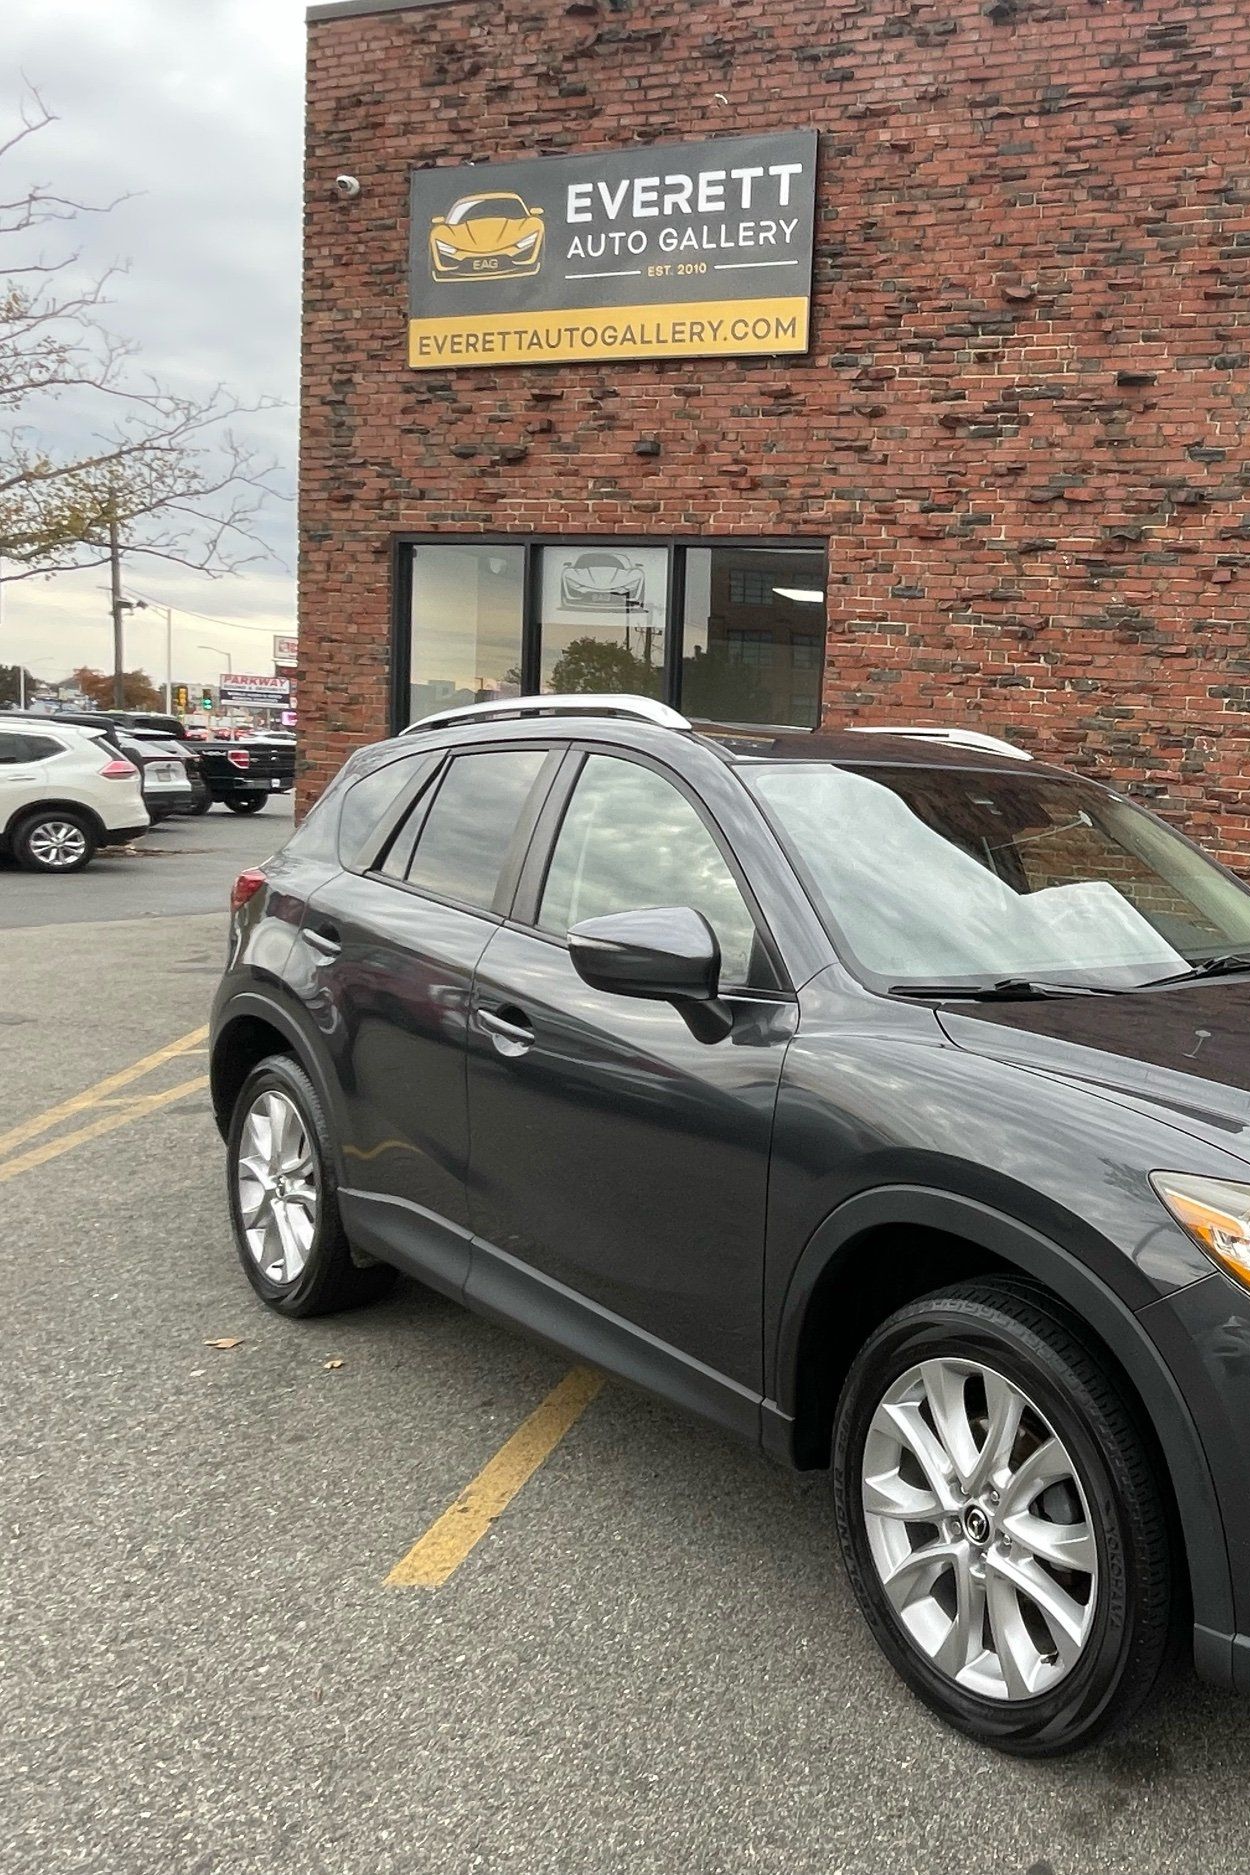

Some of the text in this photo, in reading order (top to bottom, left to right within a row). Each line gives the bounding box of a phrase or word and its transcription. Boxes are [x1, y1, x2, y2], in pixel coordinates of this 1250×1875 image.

[566, 163, 803, 224] EVERETT
[567, 218, 799, 259] AUTO GALLERY
[472, 259, 499, 271] EAG
[677, 263, 707, 275] 2010
[418, 317, 797, 356] EVERETTAUTOGALLERY.COM
[223, 675, 287, 687] PARKWAY
